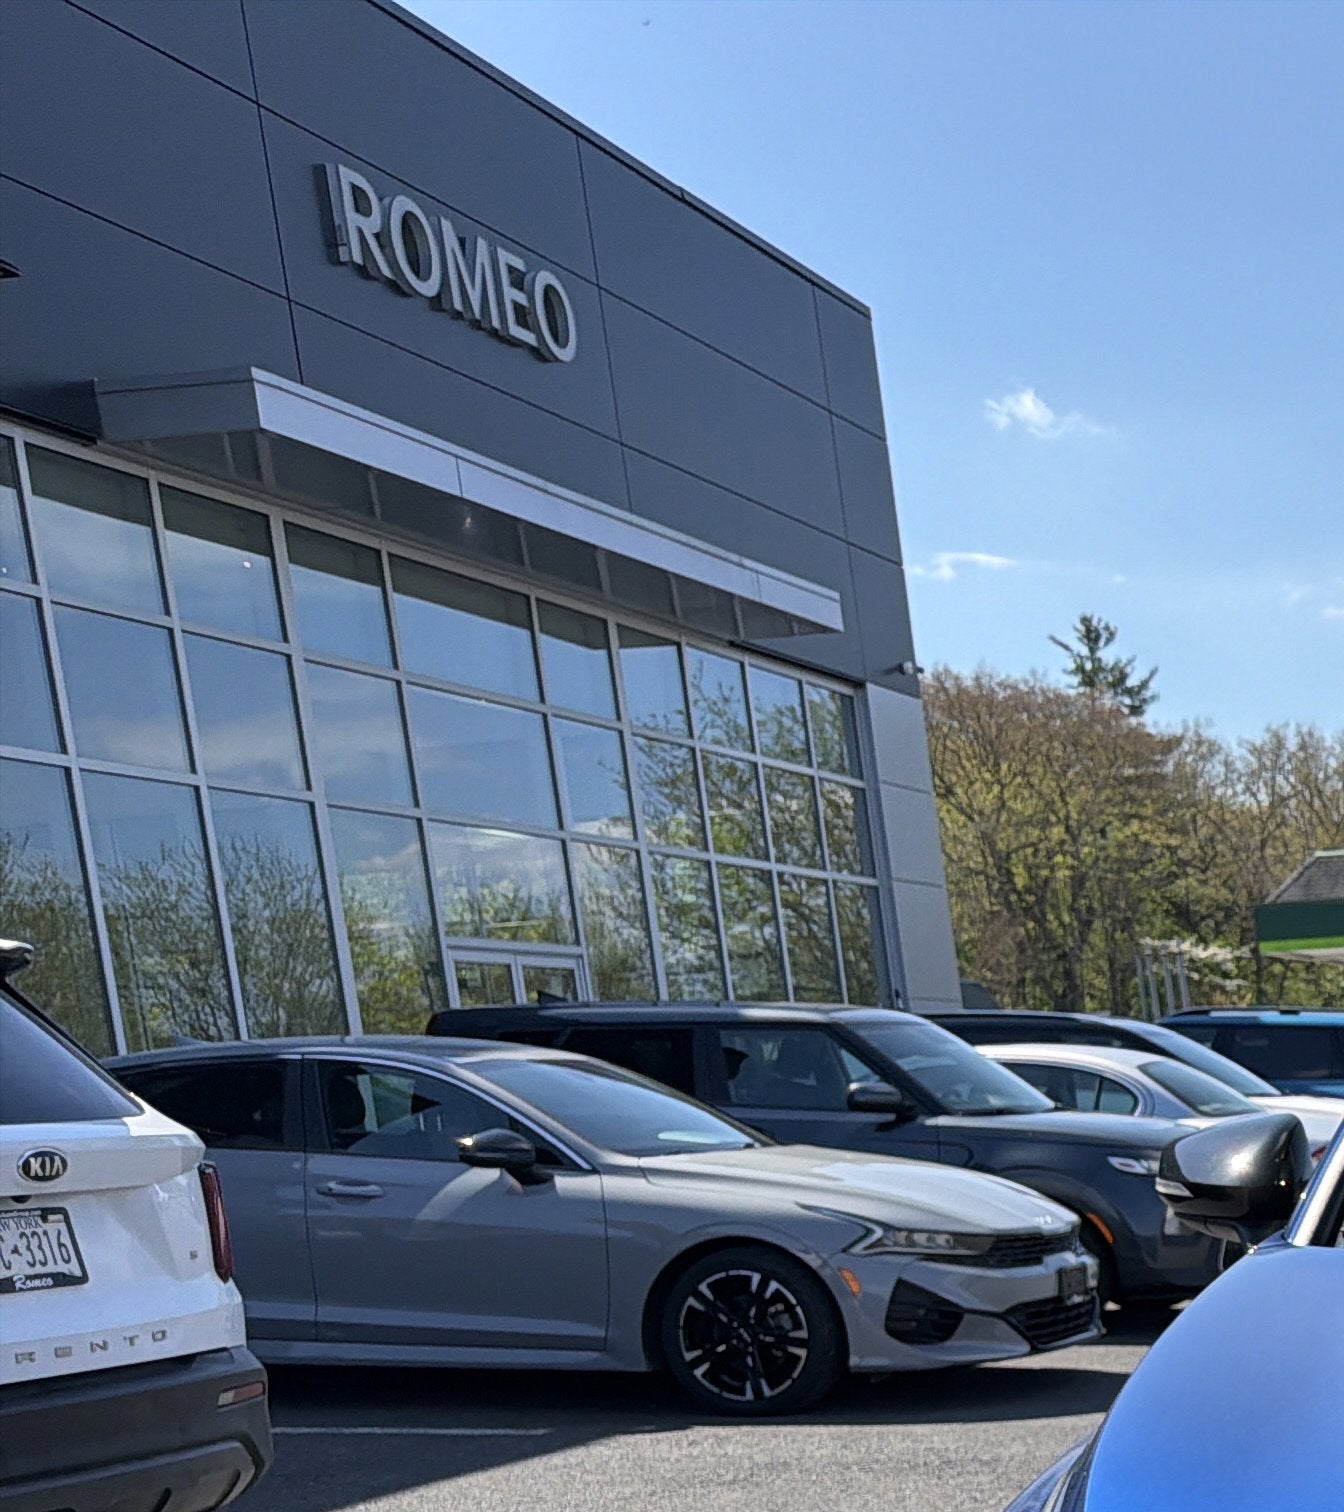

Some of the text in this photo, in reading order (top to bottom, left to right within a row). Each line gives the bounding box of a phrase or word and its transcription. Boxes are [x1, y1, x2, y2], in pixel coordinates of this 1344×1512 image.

[323, 163, 577, 362] ROMEO
[30, 1156, 63, 1177] KIA
[13, 1215, 43, 1230] YORK
[13, 1274, 54, 1290] Romeo
